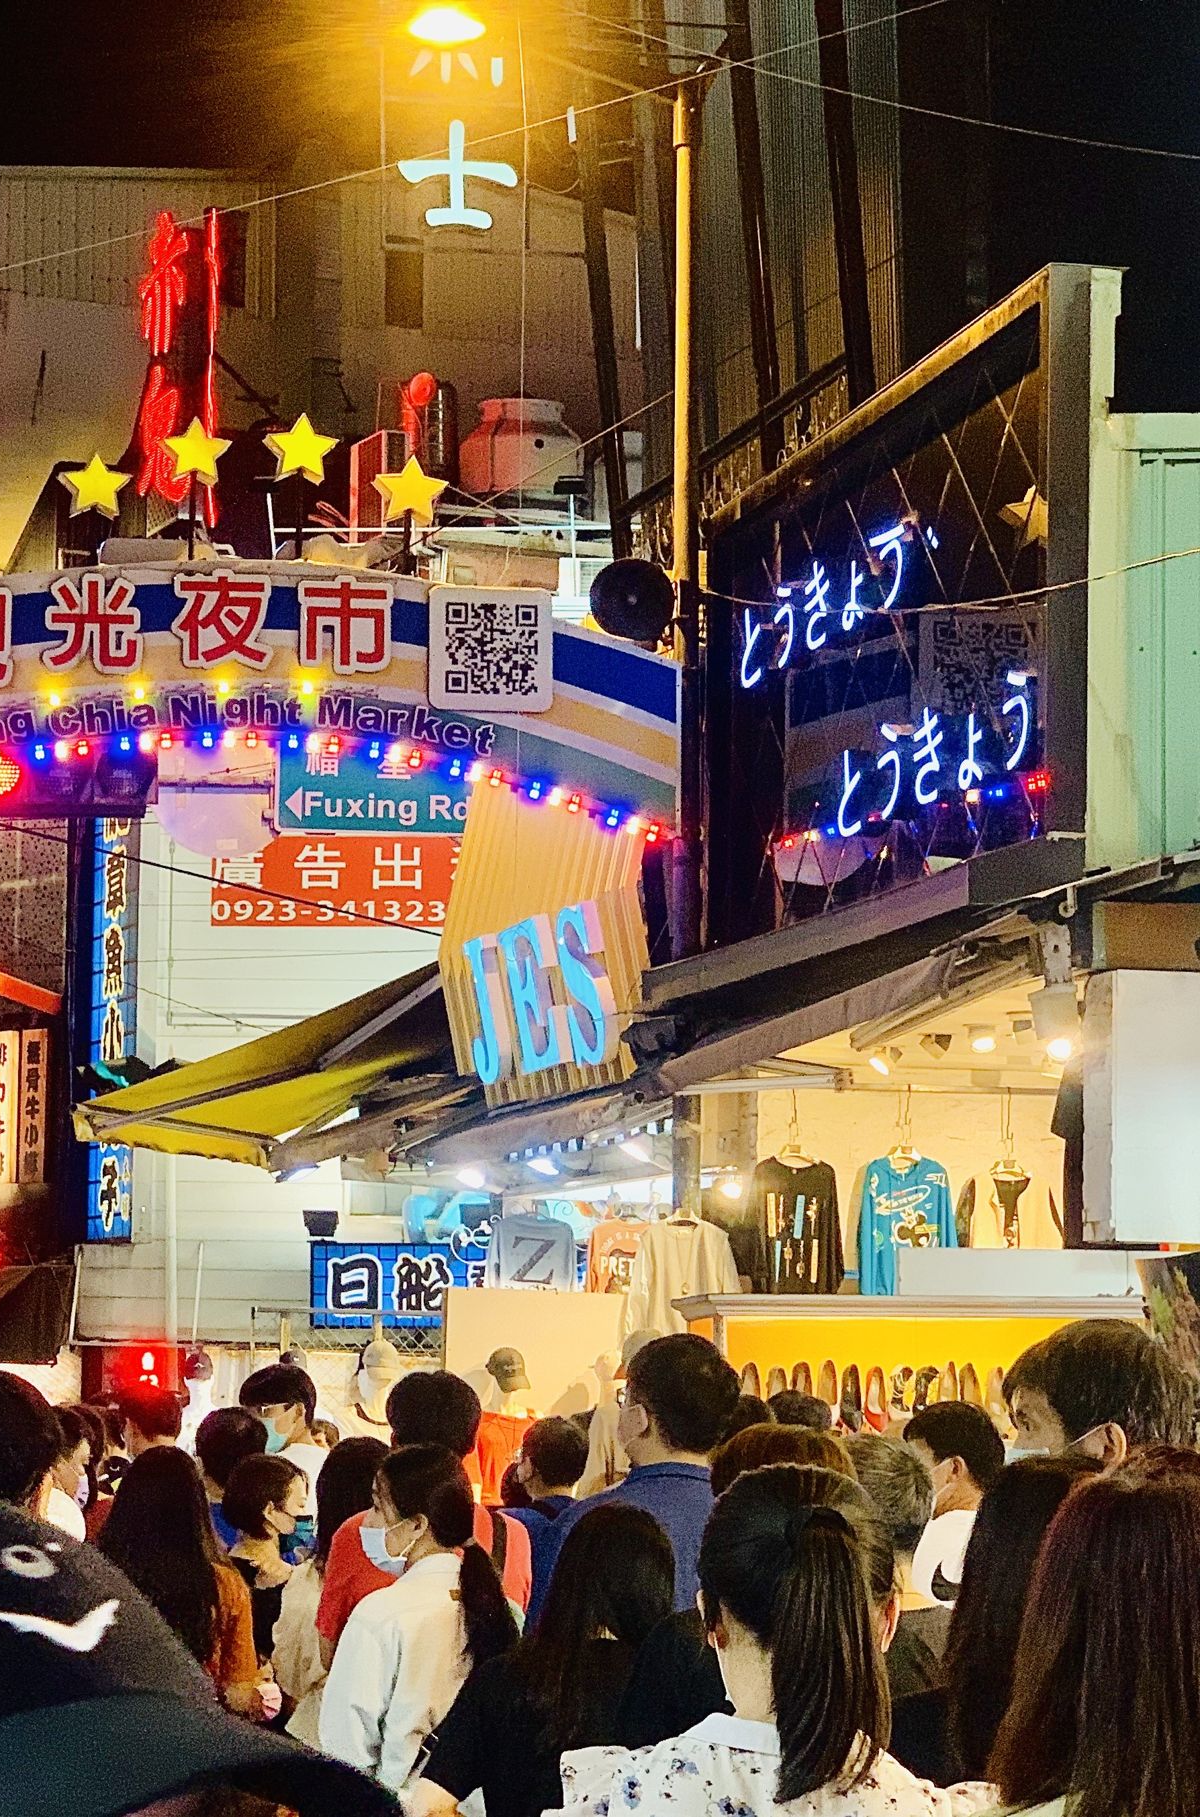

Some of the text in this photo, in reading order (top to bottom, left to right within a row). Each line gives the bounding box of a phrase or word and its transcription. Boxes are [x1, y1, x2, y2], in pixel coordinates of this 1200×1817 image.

[49, 700, 158, 738] Chia
[167, 692, 304, 731] Night
[315, 695, 497, 756] Market
[838, 670, 1029, 838] とうきょう
[305, 790, 418, 826] Fuxing
[211, 842, 462, 891] 廣告出
[211, 899, 447, 923] 0923-341323
[464, 900, 606, 1085] JES
[329, 1255, 486, 1319] 日船
[509, 1235, 557, 1285] Z
